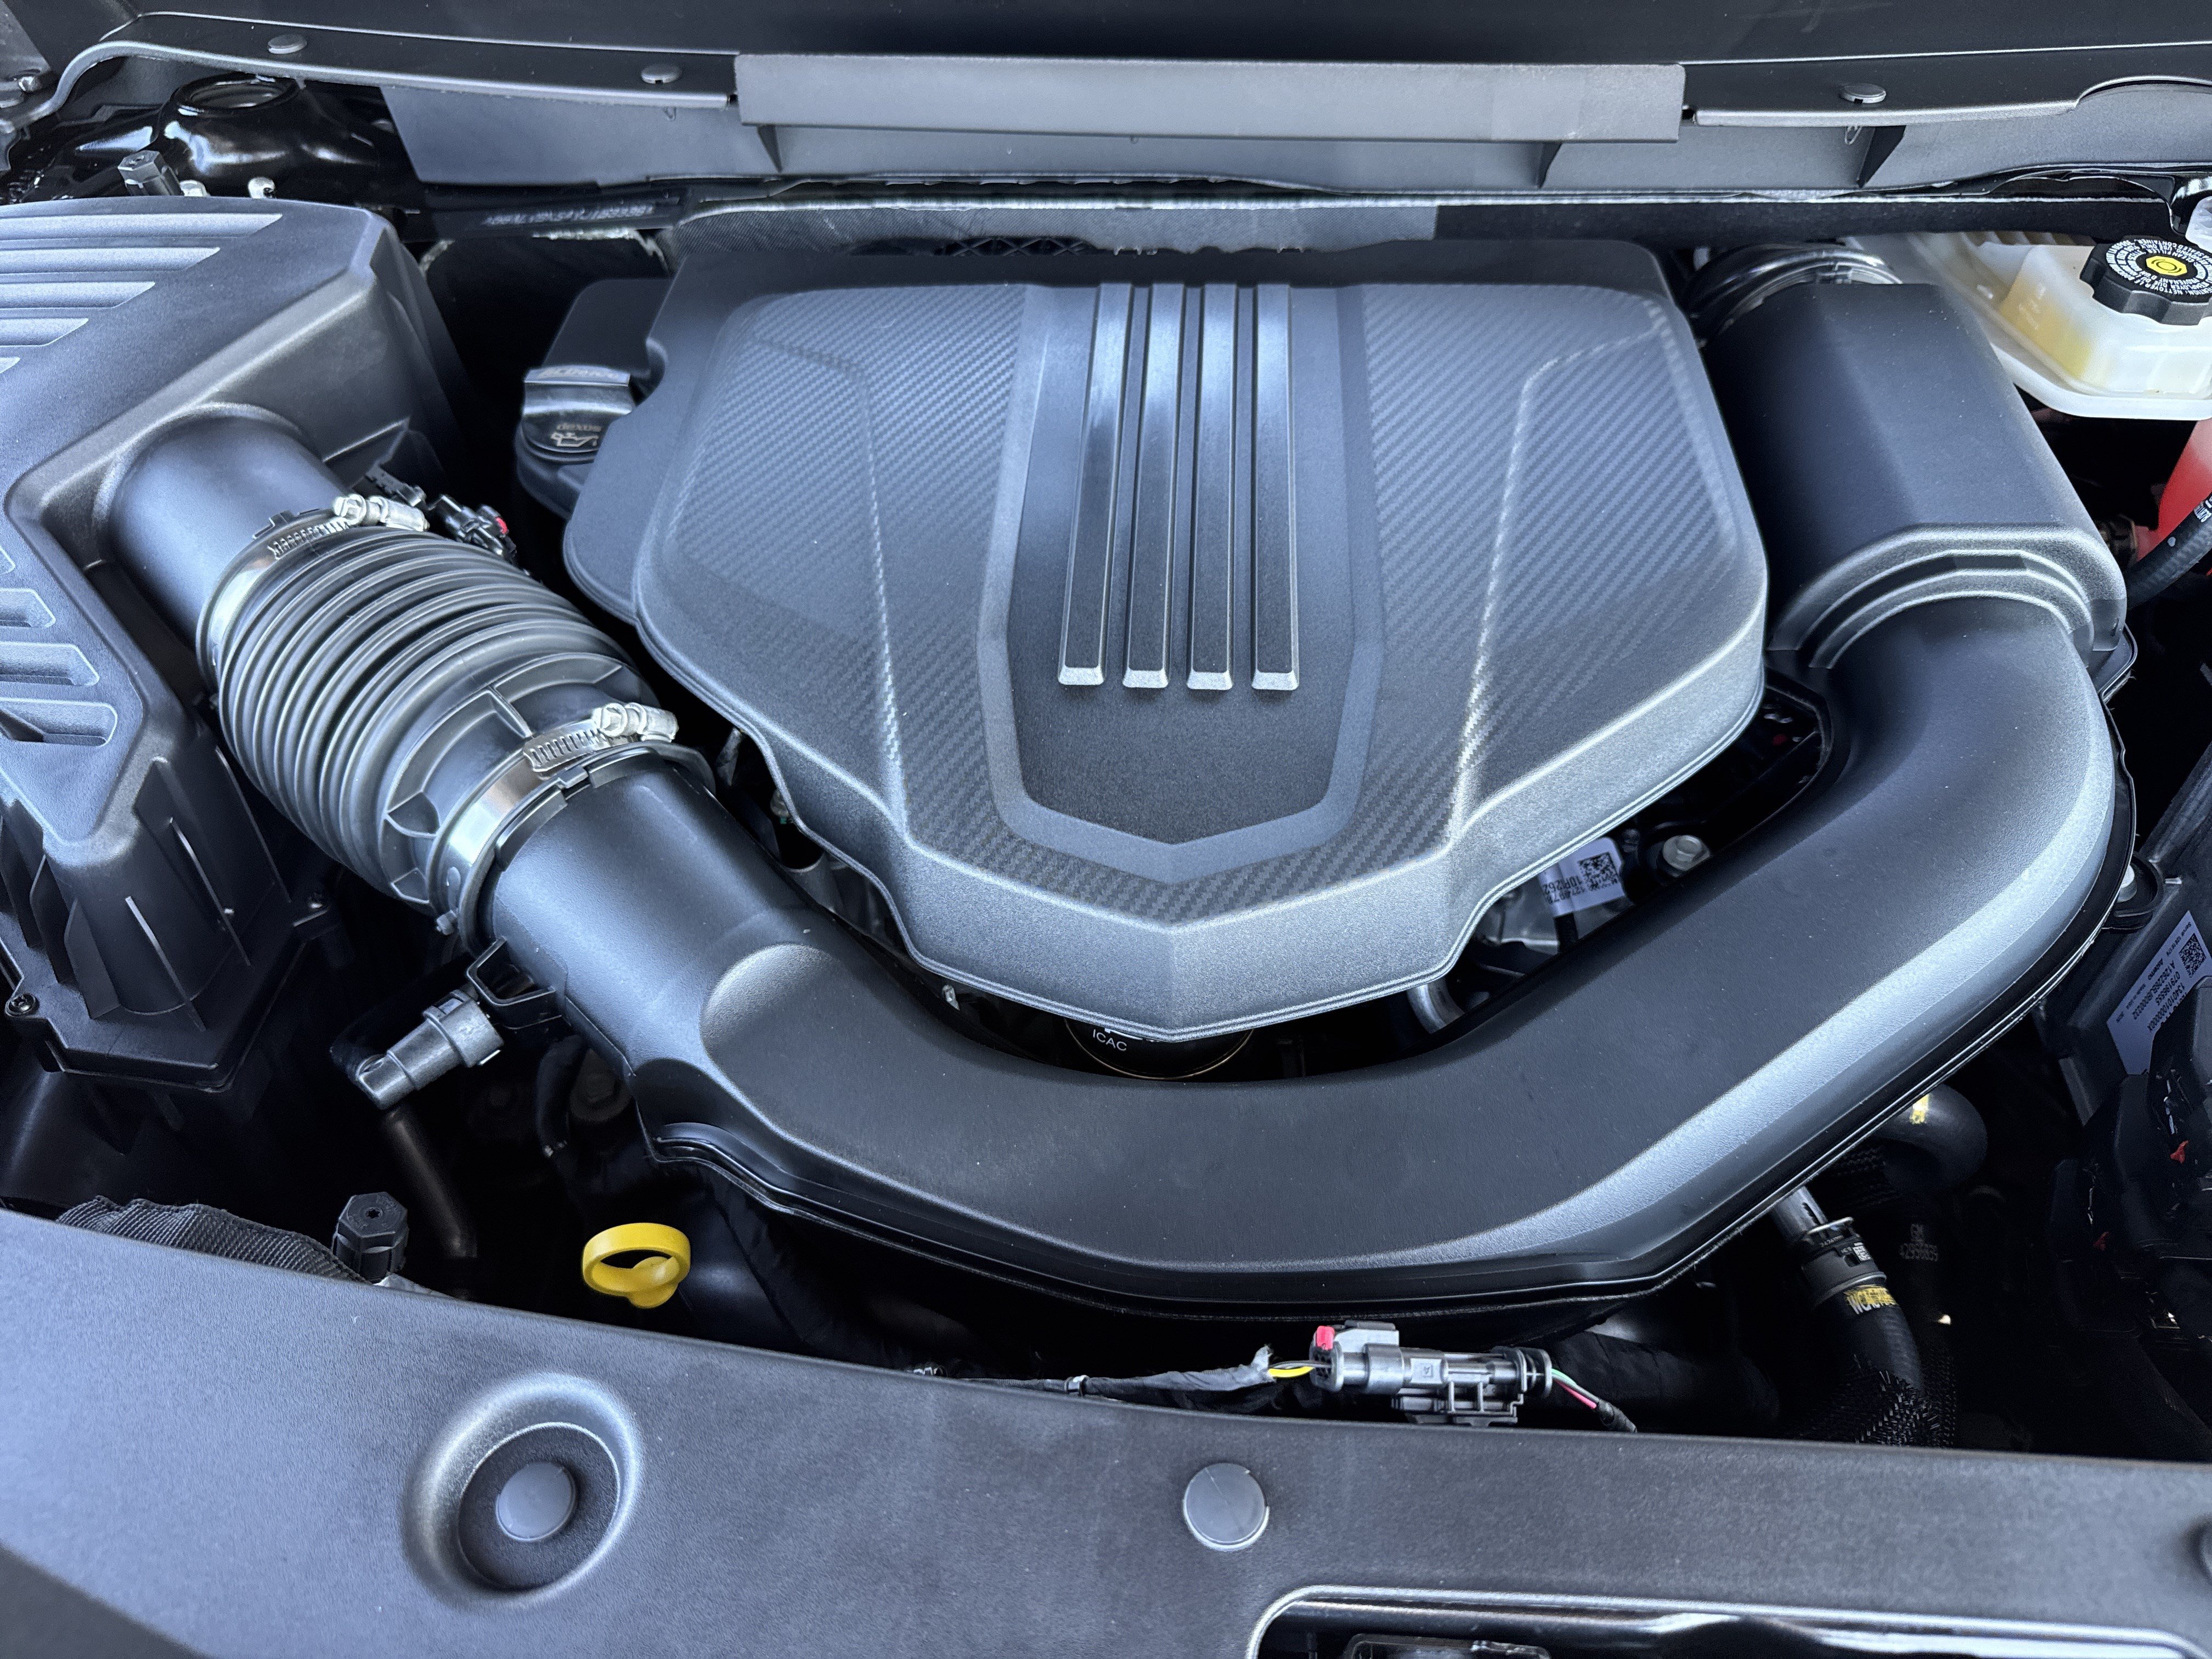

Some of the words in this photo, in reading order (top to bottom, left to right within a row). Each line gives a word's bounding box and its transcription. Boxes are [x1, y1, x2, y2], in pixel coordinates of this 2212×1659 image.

[2178, 245, 2204, 256] SEALED
[2172, 252, 2194, 262] CLEAN
[2145, 283, 2183, 295] NETTOYER
